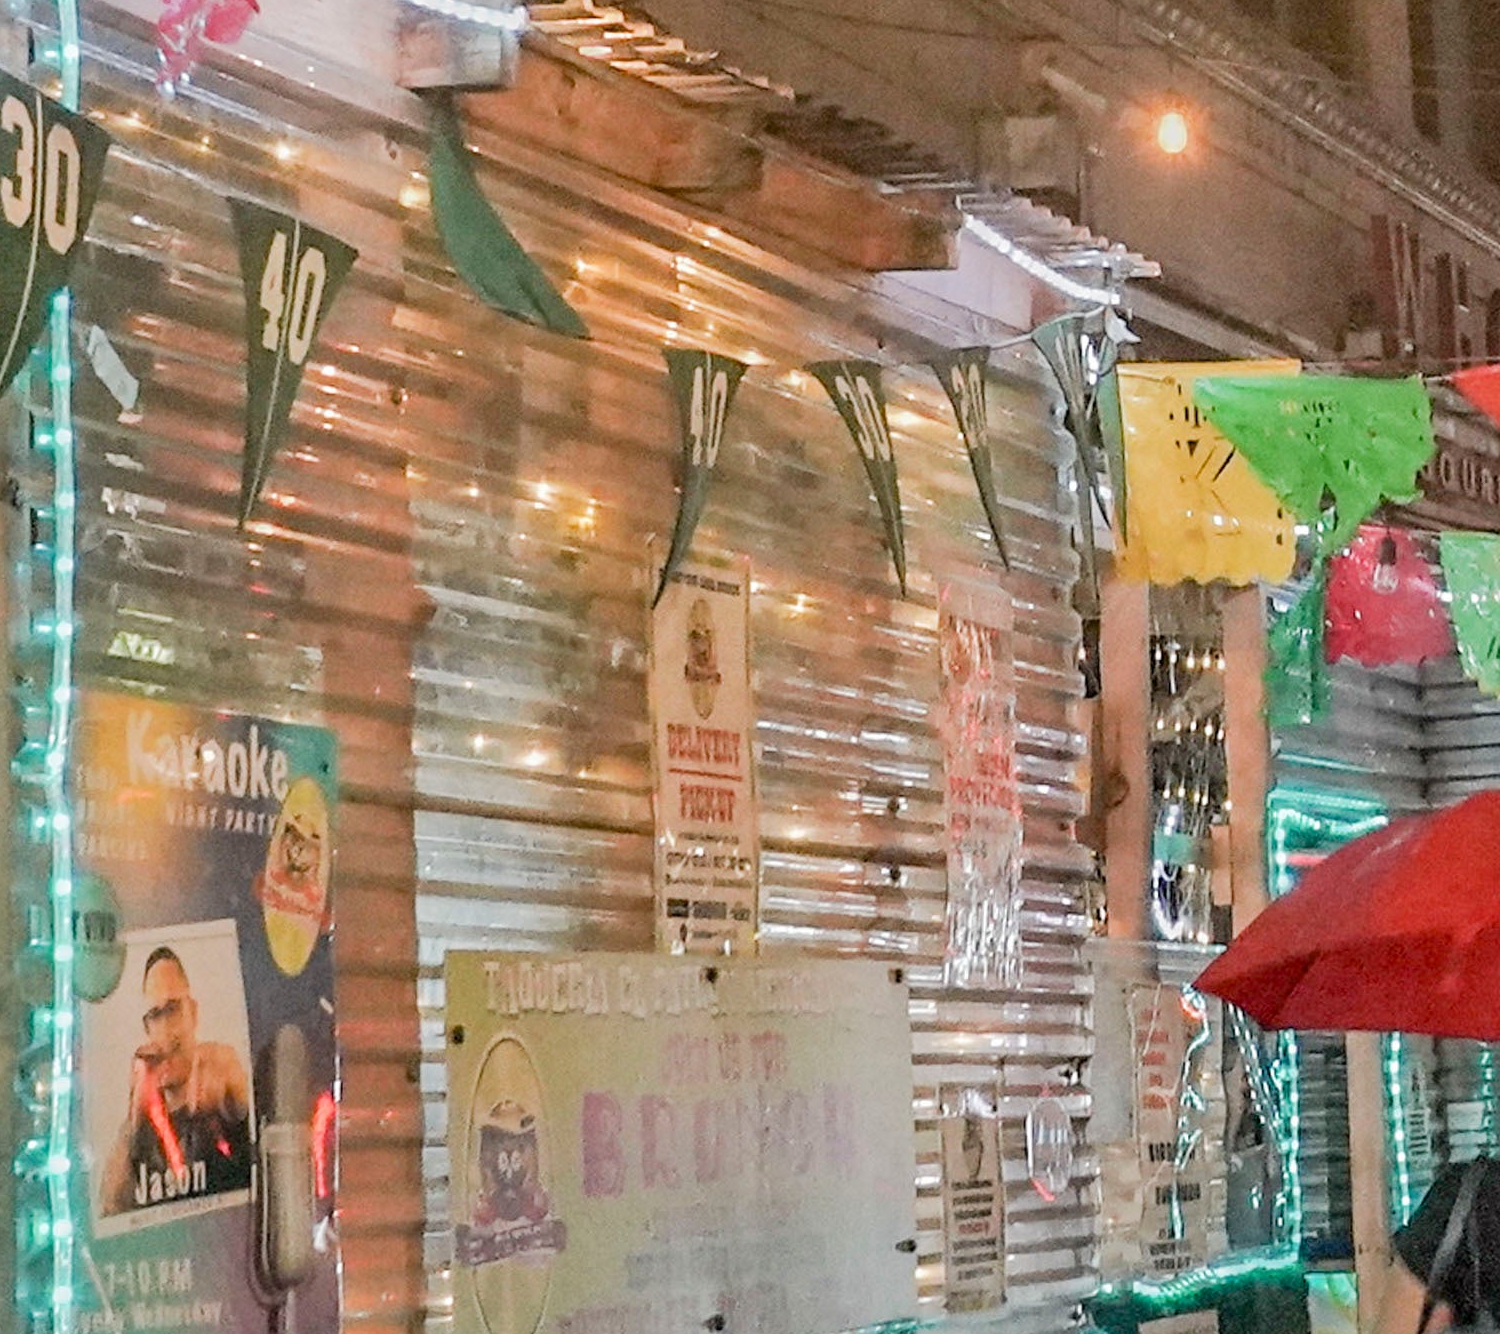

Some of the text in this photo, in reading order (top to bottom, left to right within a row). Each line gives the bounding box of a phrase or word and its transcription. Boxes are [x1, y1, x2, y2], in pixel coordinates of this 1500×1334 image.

[260, 230, 327, 366] 40
[126, 709, 289, 804] Karaoke
[224, 808, 277, 836] PARTY
[134, 1160, 207, 1206] Jason
